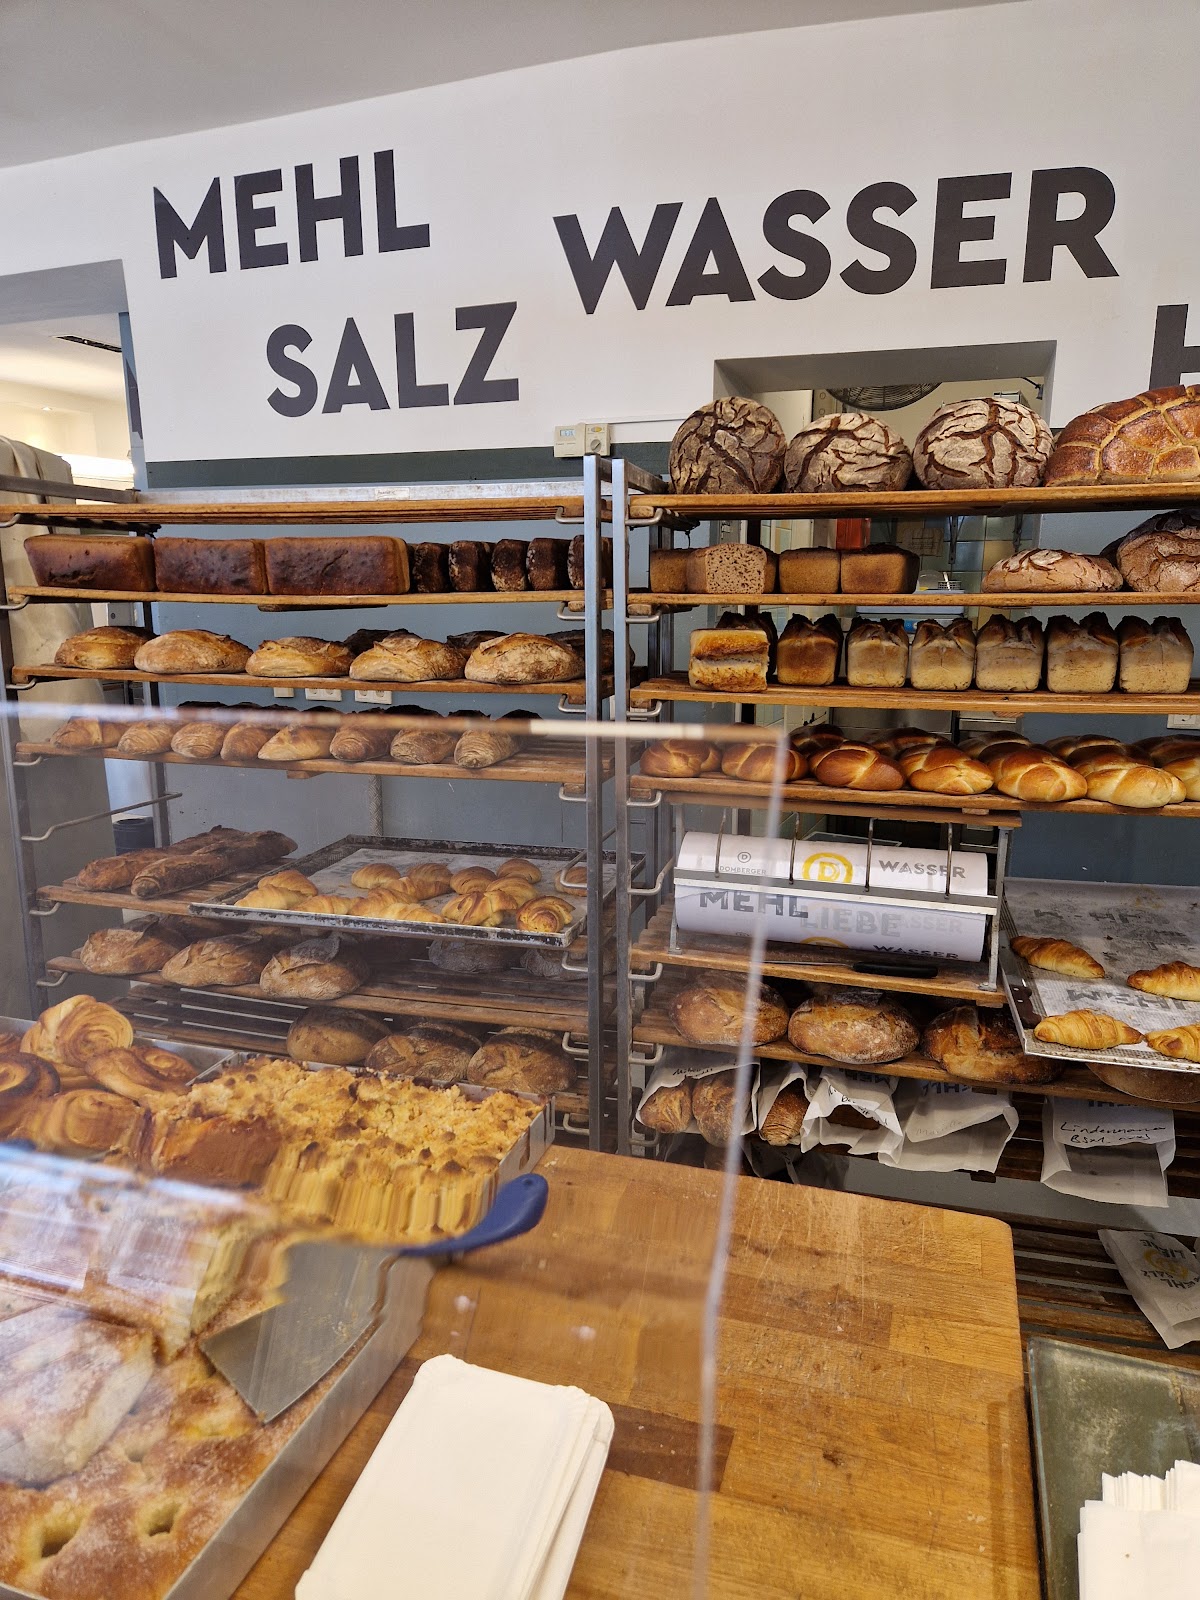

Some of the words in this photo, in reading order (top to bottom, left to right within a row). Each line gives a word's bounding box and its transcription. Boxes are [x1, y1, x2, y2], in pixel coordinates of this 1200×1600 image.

[153, 149, 430, 280] MEHL
[553, 165, 1120, 315] WASSER
[266, 301, 520, 418] SALZ
[699, 889, 809, 919] MEHL
[719, 865, 767, 876] DOMBERGER
[879, 860, 966, 879] WASSER
